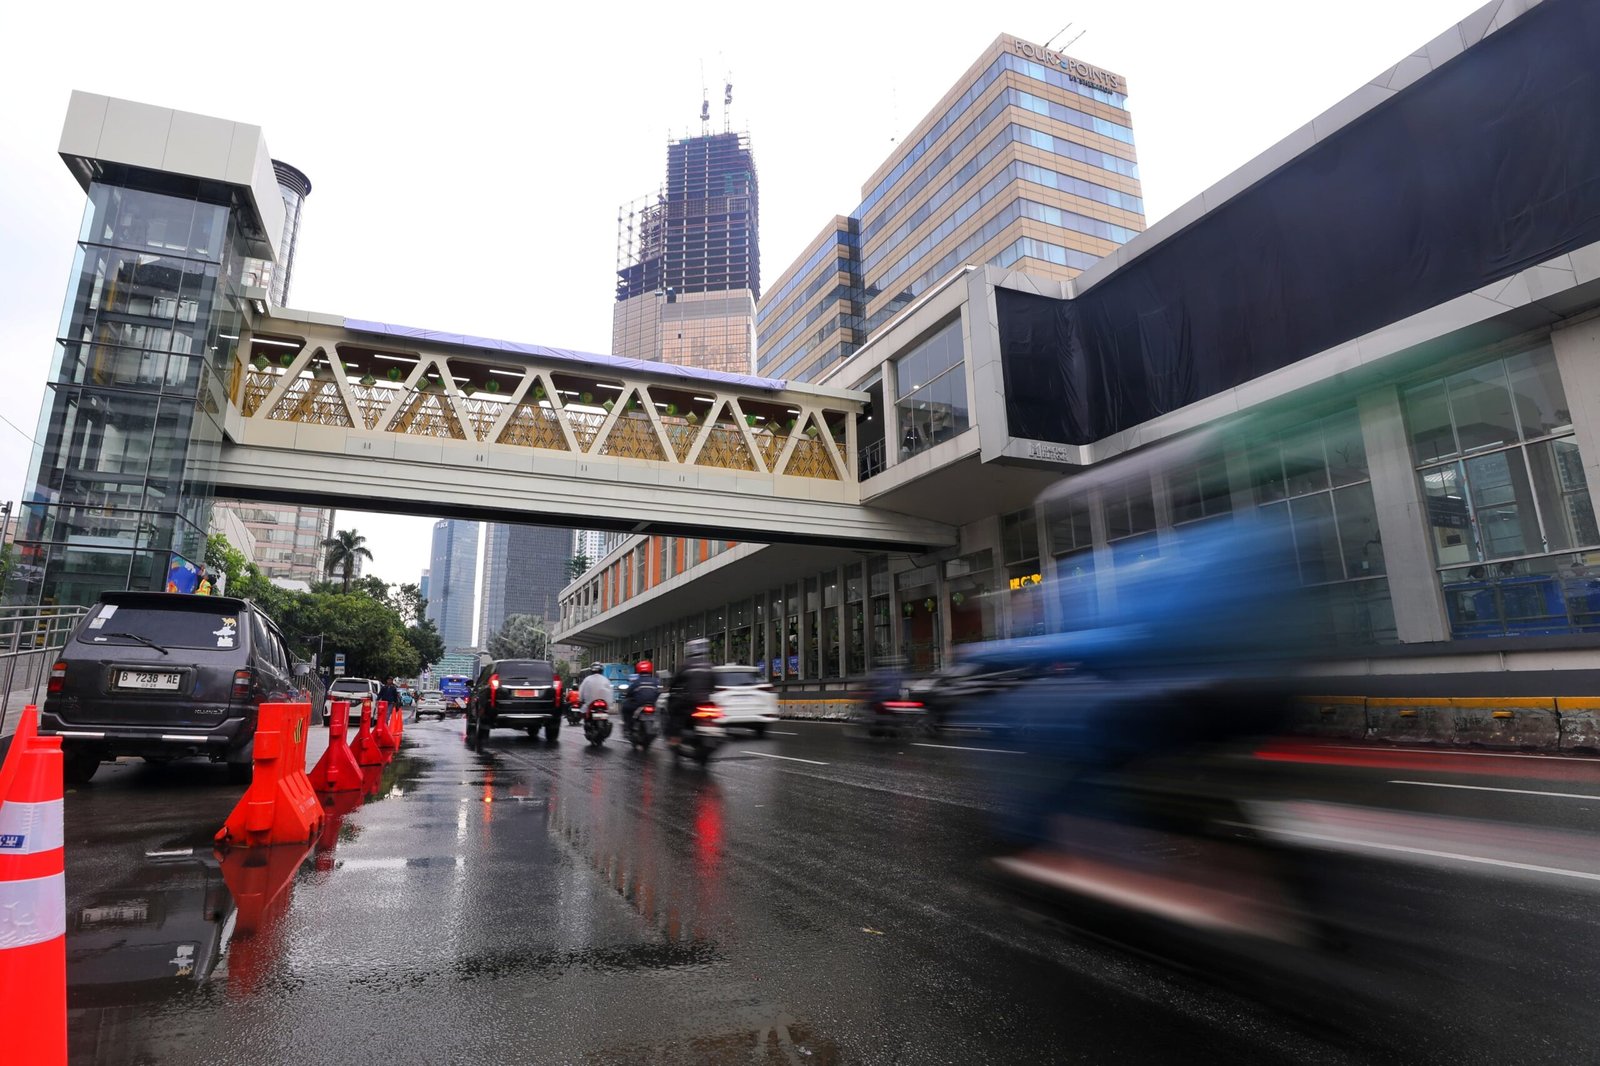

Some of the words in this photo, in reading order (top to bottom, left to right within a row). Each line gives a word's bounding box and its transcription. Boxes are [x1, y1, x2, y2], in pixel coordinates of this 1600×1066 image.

[1014, 39, 1055, 66] FOUR
[1068, 59, 1118, 89] POINTS
[122, 672, 128, 681] B
[136, 673, 158, 682] 7238
[167, 675, 178, 684] AE
